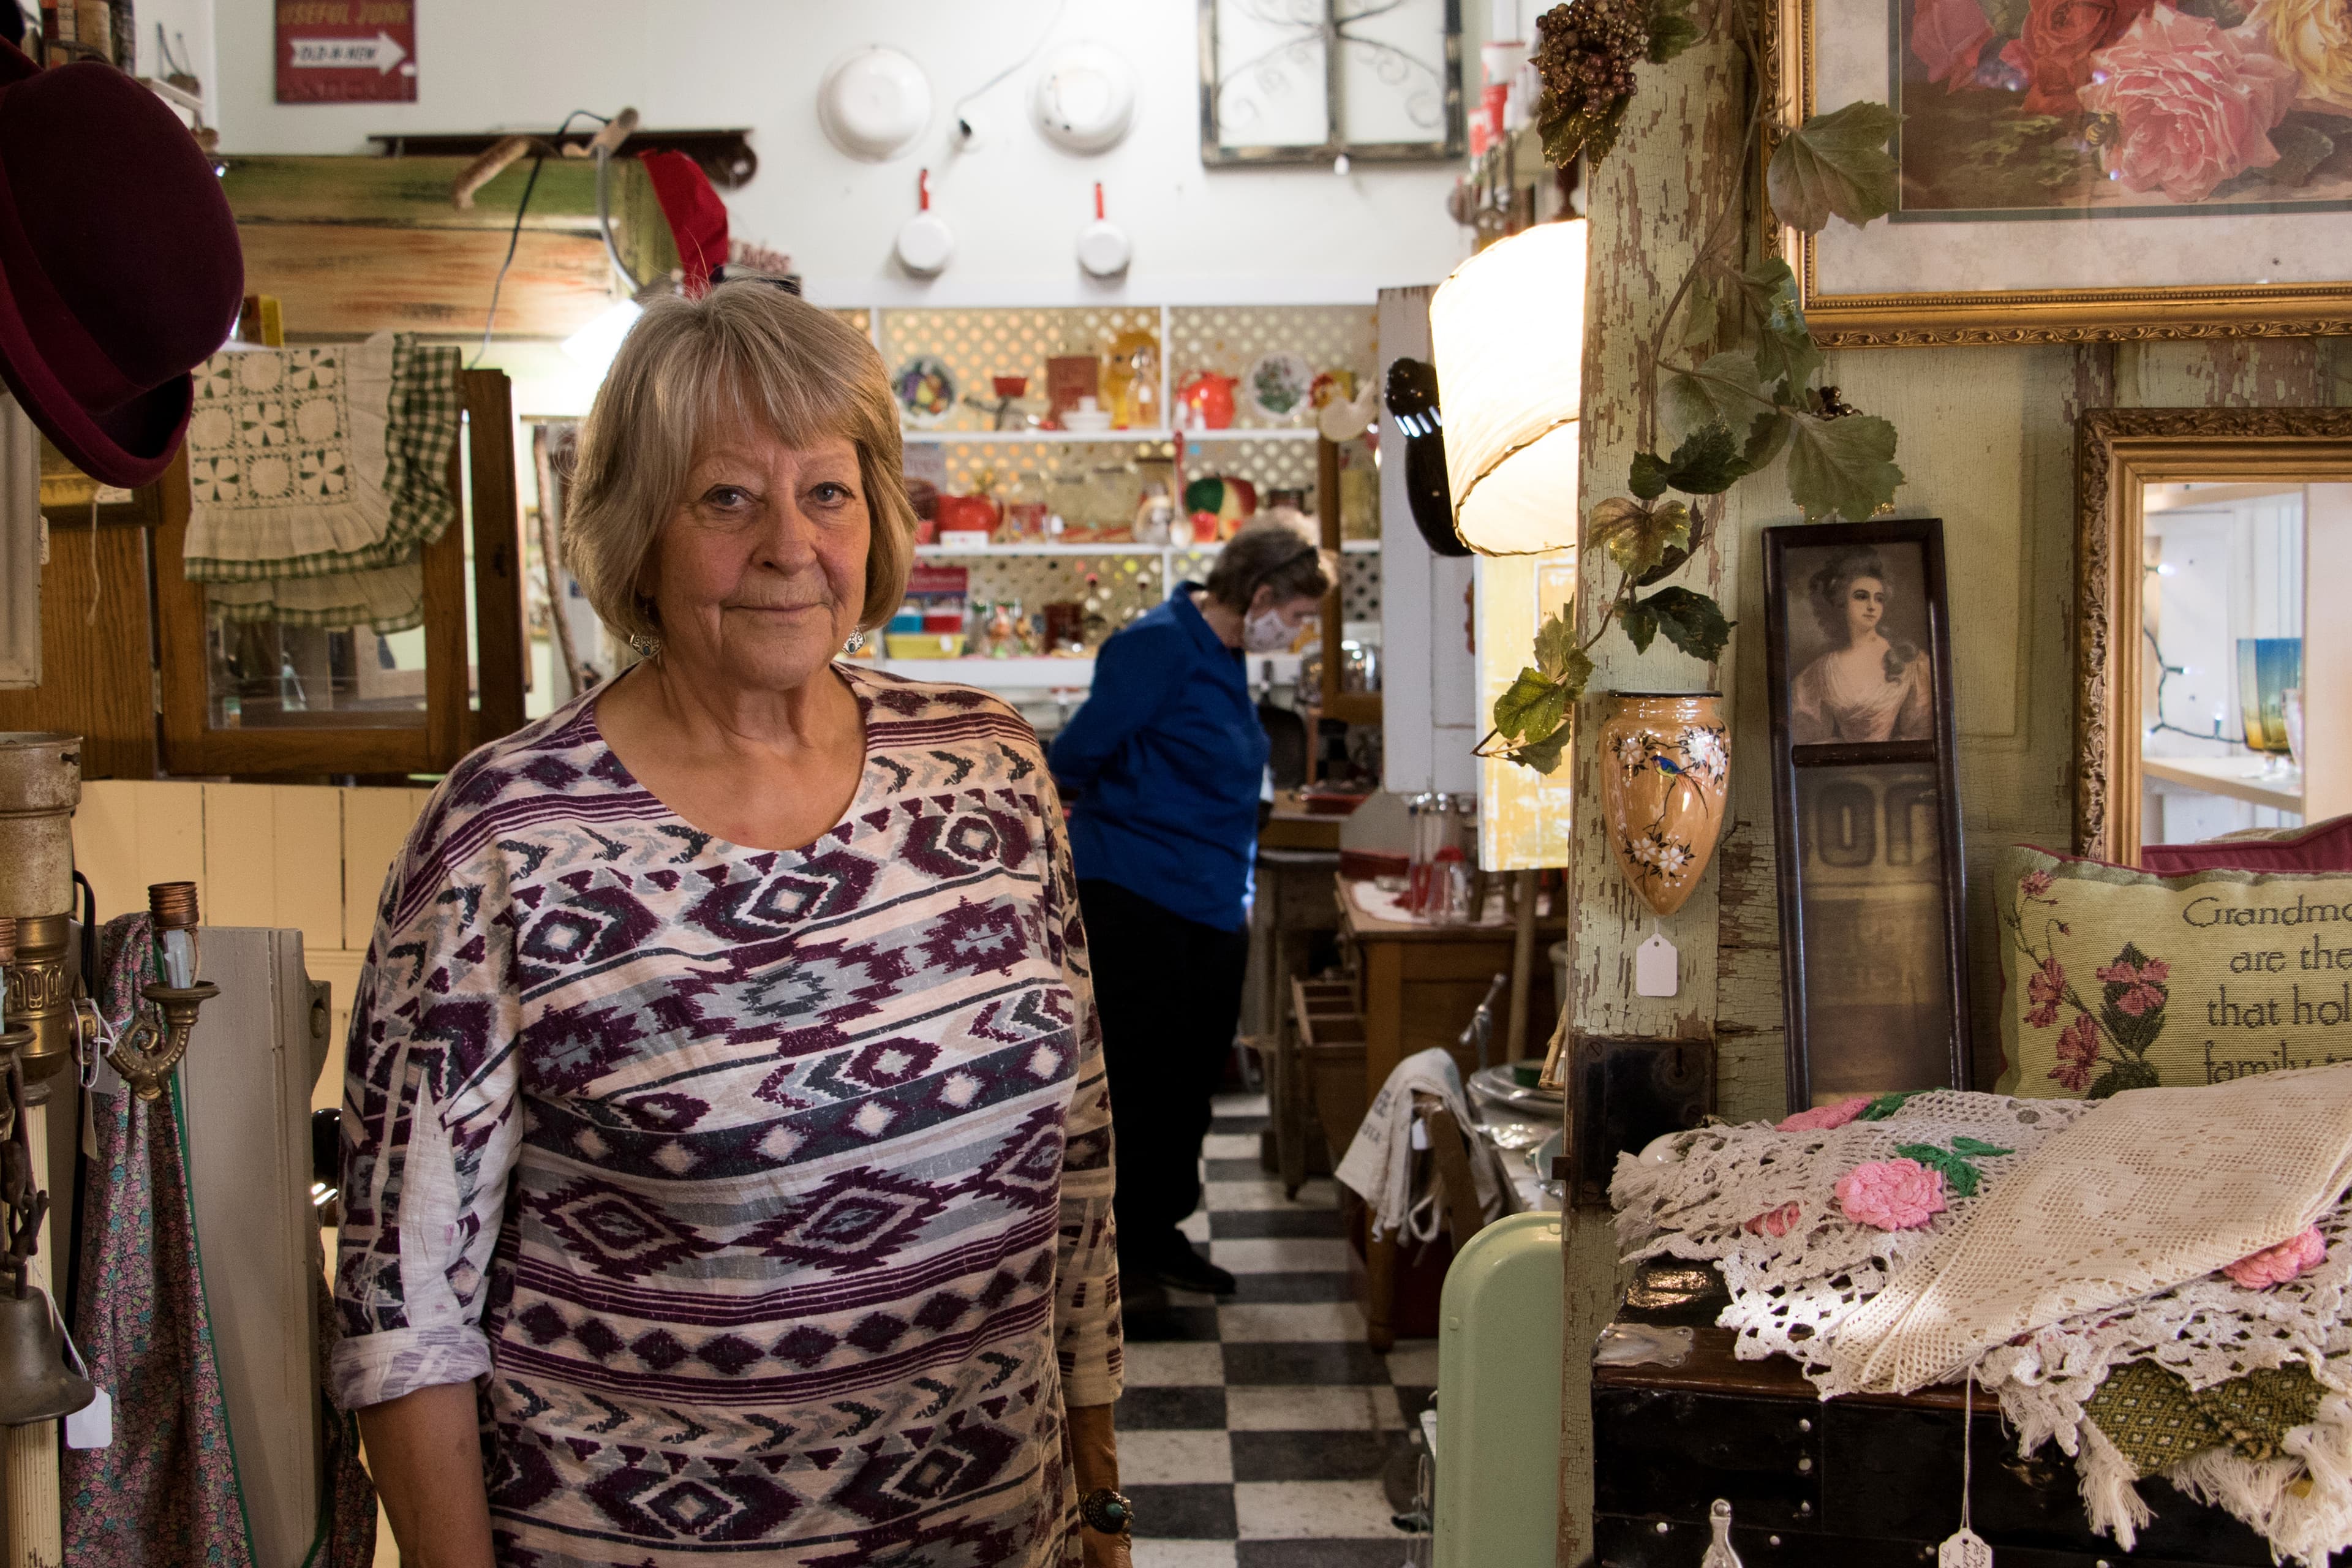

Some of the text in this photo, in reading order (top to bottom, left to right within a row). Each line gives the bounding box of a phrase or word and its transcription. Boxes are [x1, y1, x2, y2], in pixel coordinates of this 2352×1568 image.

[2230, 932, 2352, 973] are the
[2207, 984, 2281, 1029] that
